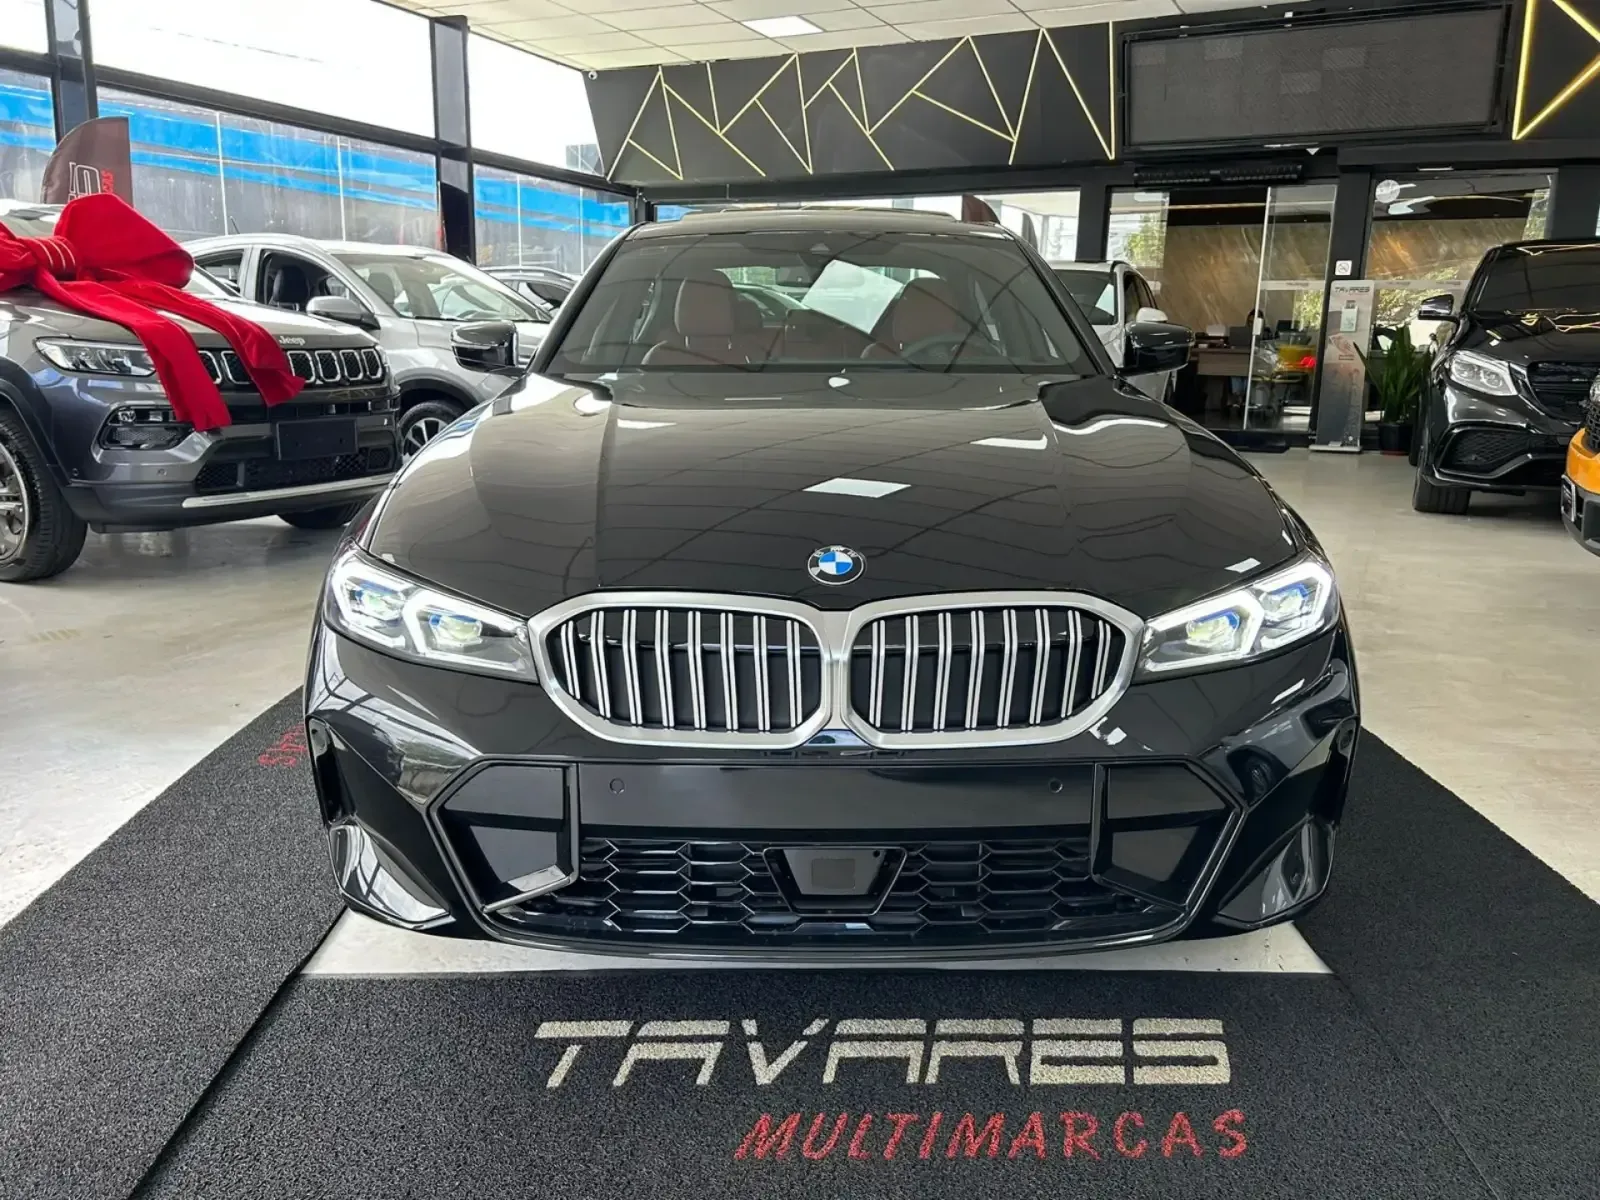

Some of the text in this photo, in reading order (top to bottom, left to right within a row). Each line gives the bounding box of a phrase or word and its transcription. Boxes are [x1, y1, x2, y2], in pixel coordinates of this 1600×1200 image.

[279, 335, 306, 346] Jeep
[534, 1018, 1231, 1087] TAVARES
[734, 1109, 1248, 1160] MULTIMARCAS
